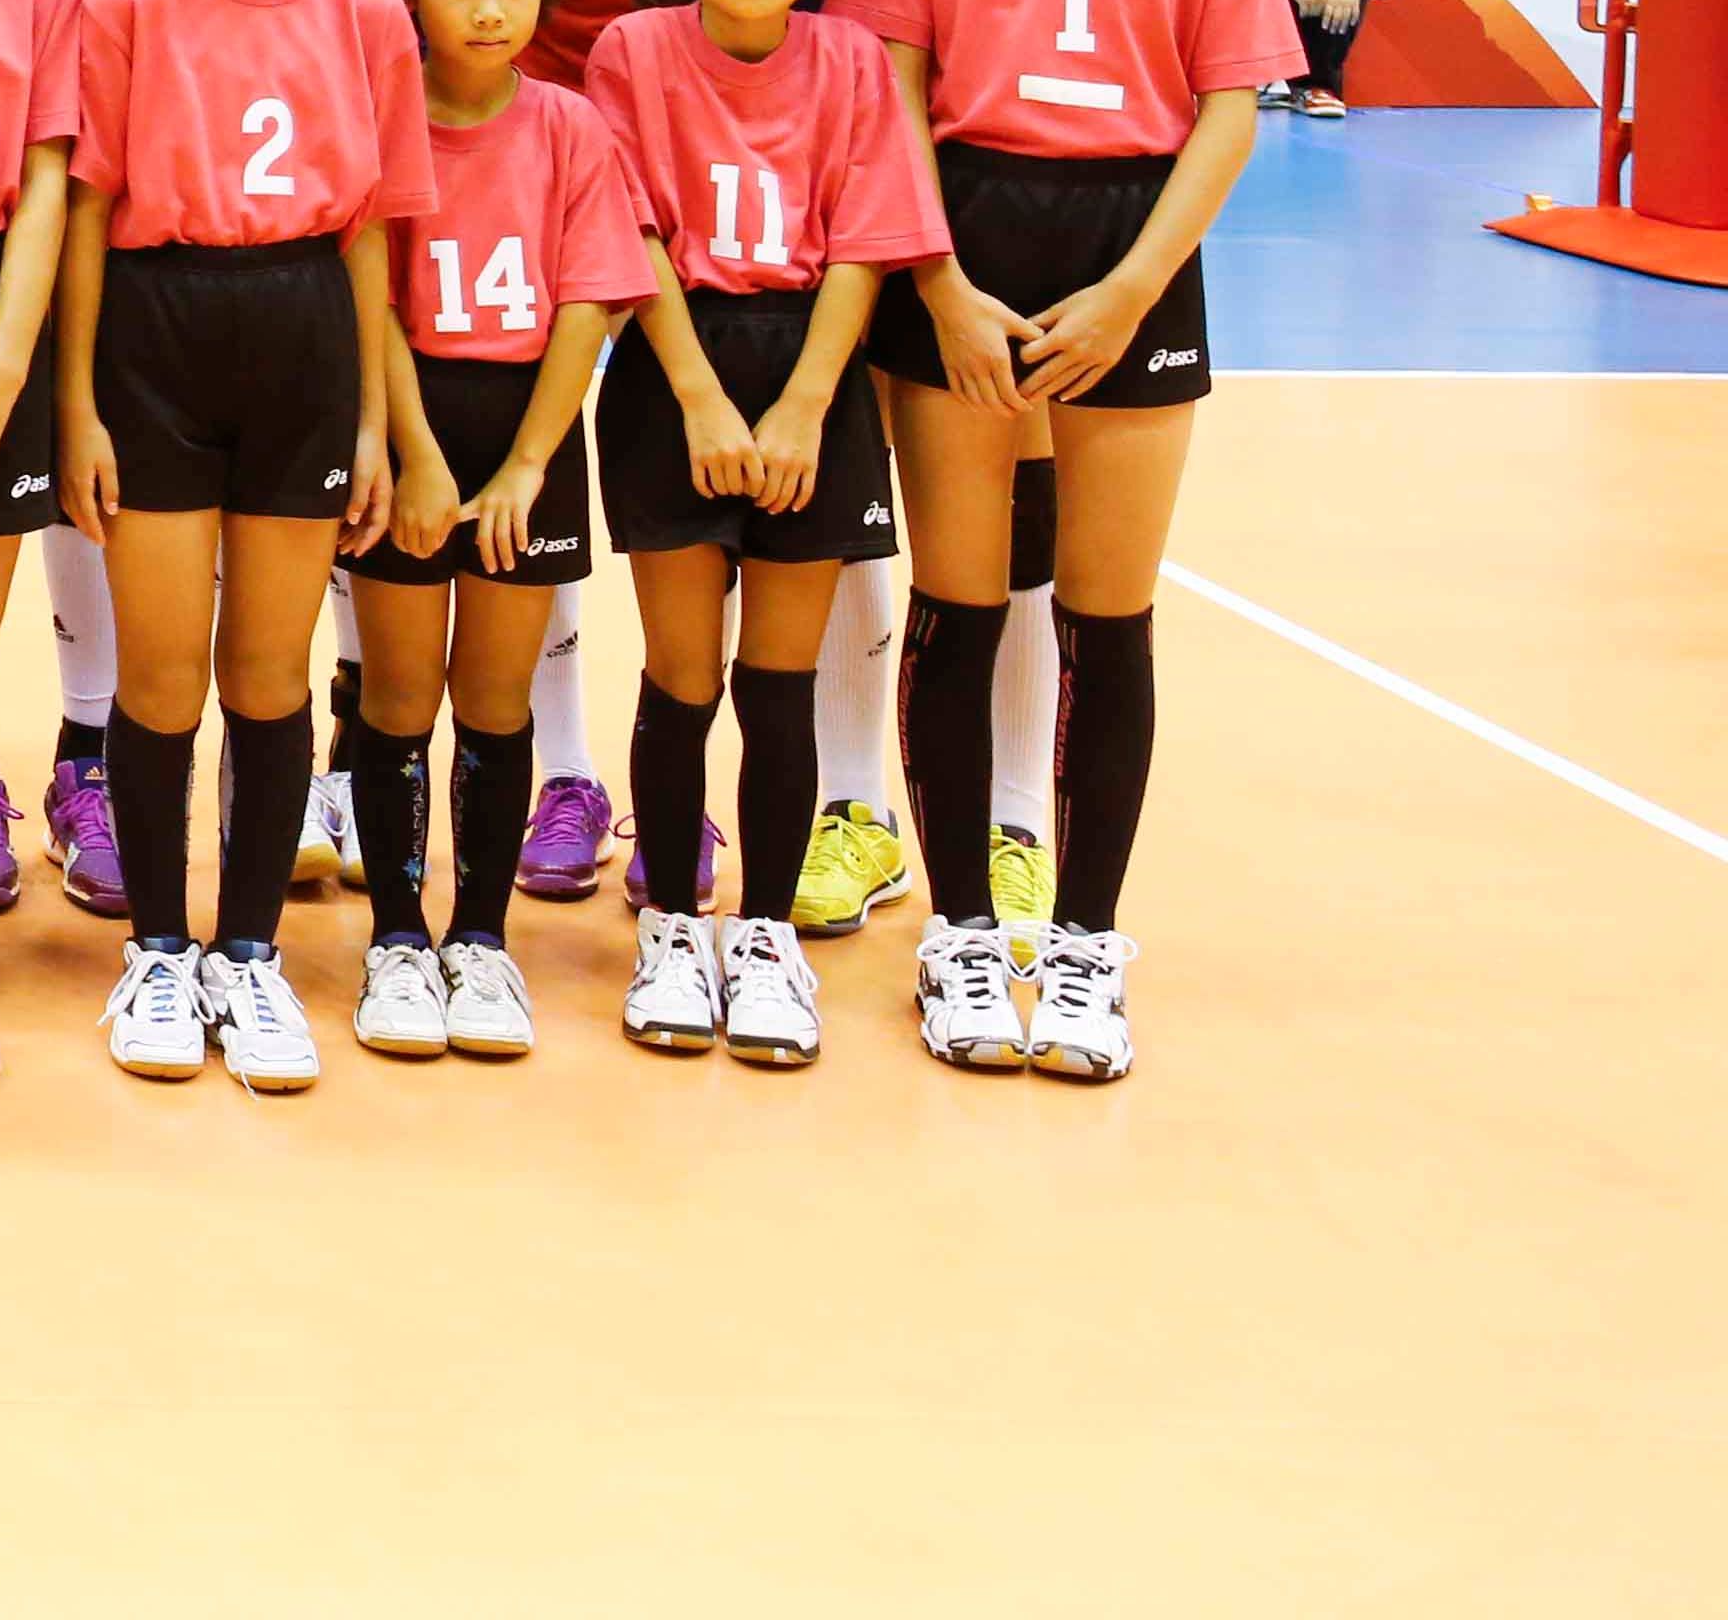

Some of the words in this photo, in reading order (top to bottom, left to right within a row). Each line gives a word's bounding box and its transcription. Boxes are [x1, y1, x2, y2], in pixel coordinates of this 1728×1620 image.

[241, 96, 296, 196] 2
[708, 162, 792, 266] 11
[428, 235, 538, 333] 14
